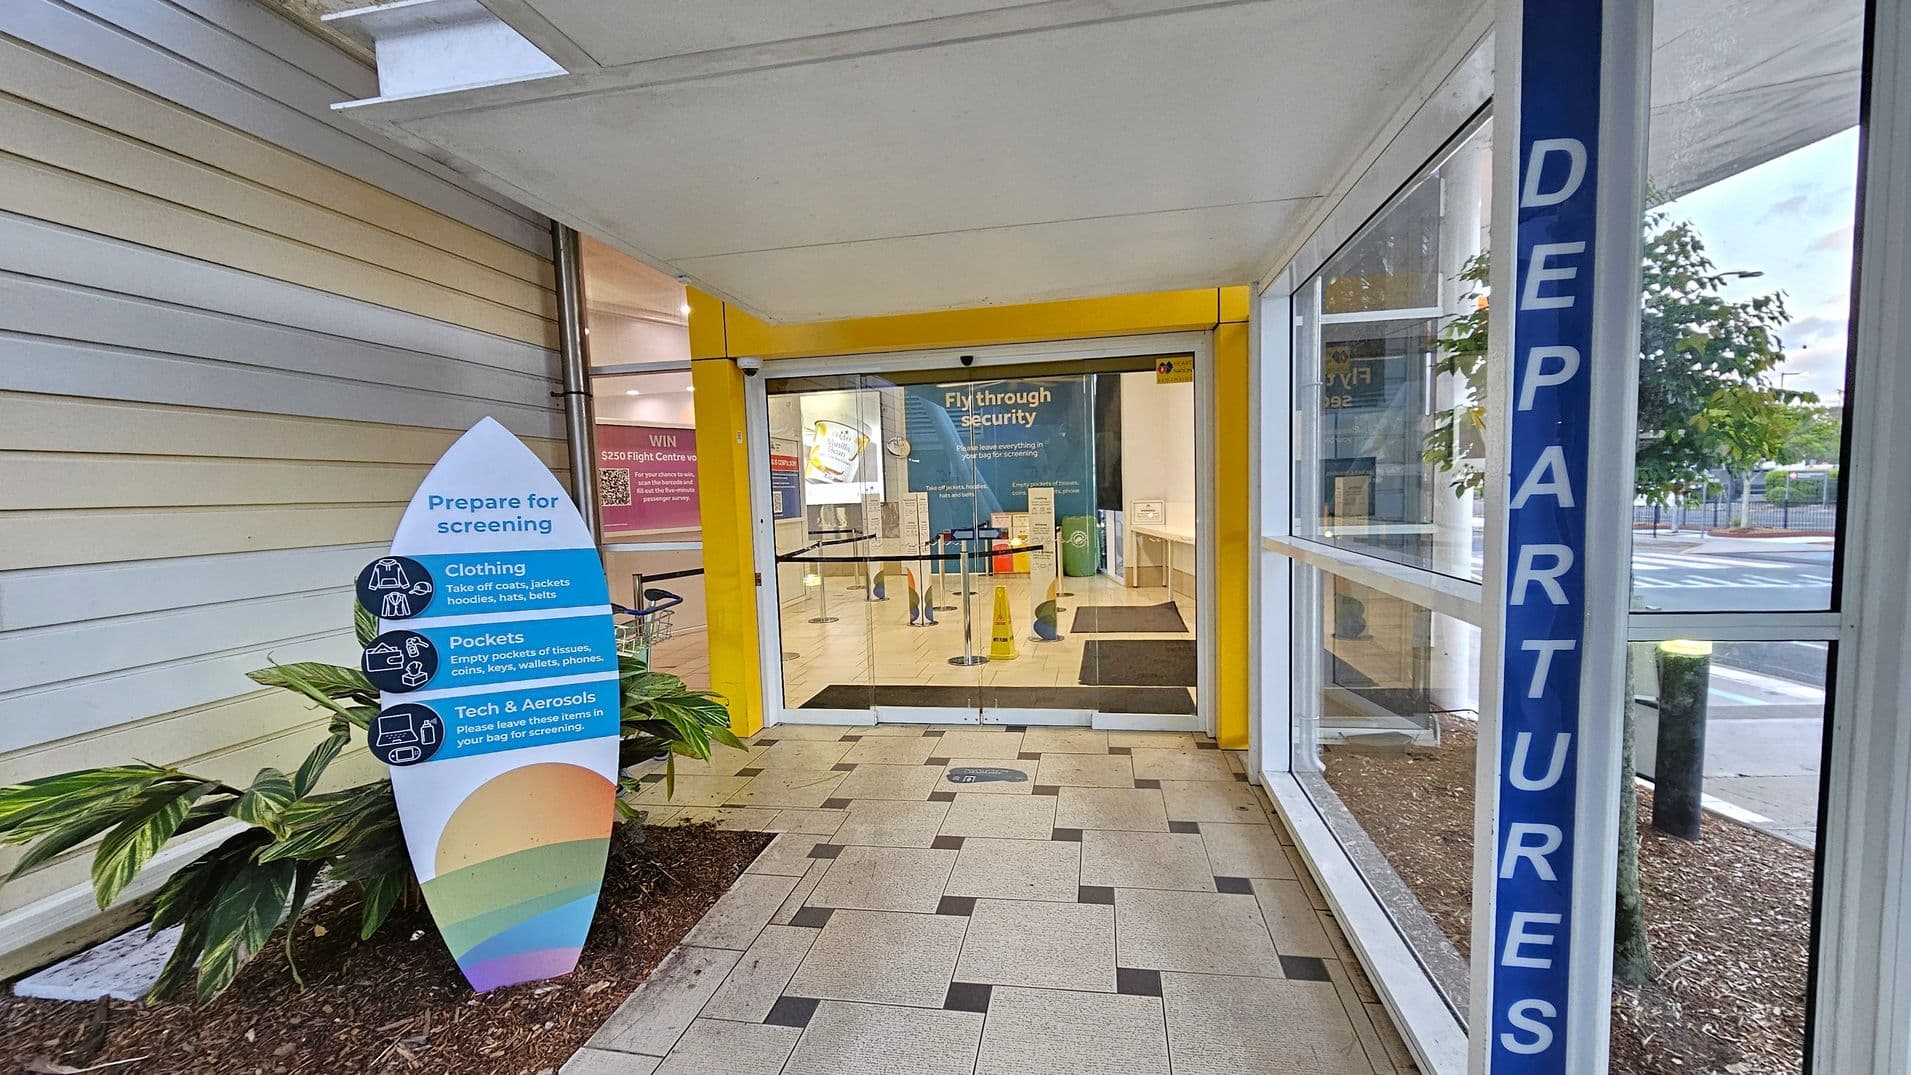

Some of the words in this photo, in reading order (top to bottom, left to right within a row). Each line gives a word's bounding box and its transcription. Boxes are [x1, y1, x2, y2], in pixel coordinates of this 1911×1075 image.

[945, 392, 971, 411] Fly
[976, 387, 1051, 408] through
[961, 409, 1037, 428] security
[649, 434, 677, 448] WIN
[956, 444, 979, 452] Please
[998, 441, 1035, 451] everything
[601, 450, 626, 461] $250
[627, 451, 655, 463] Flight
[655, 452, 686, 462] Centre
[962, 453, 977, 461] your
[992, 450, 1002, 458] for
[429, 494, 521, 513] Prepare
[527, 493, 559, 509] for
[437, 516, 552, 534] screening
[445, 561, 526, 577] Clothing
[446, 583, 474, 593] Take
[477, 581, 493, 591] off
[495, 580, 529, 590] coats,
[530, 578, 571, 590] jackets
[447, 595, 497, 605] hoodies,
[499, 592, 527, 603] hats,
[529, 591, 557, 600] belts
[1500, 138, 1587, 1054] DEPARTURES
[450, 631, 525, 649] Pockets
[450, 653, 489, 665] Empty
[492, 649, 537, 661] pockets
[538, 646, 550, 656] of
[552, 644, 592, 655] tissues,
[451, 665, 486, 676] coins,
[487, 663, 517, 674] keys,
[518, 659, 561, 670] wallets,
[562, 654, 605, 667] phones.
[454, 702, 499, 719] Tech
[504, 700, 517, 713] &
[521, 691, 597, 712] Aerosols
[456, 722, 494, 735] Please
[497, 720, 526, 730] leave
[528, 715, 560, 725] these
[561, 711, 592, 721] items
[593, 708, 604, 717] in
[456, 736, 484, 748] your
[486, 733, 508, 743] bag
[511, 729, 526, 739] for
[528, 723, 585, 738] screening.
